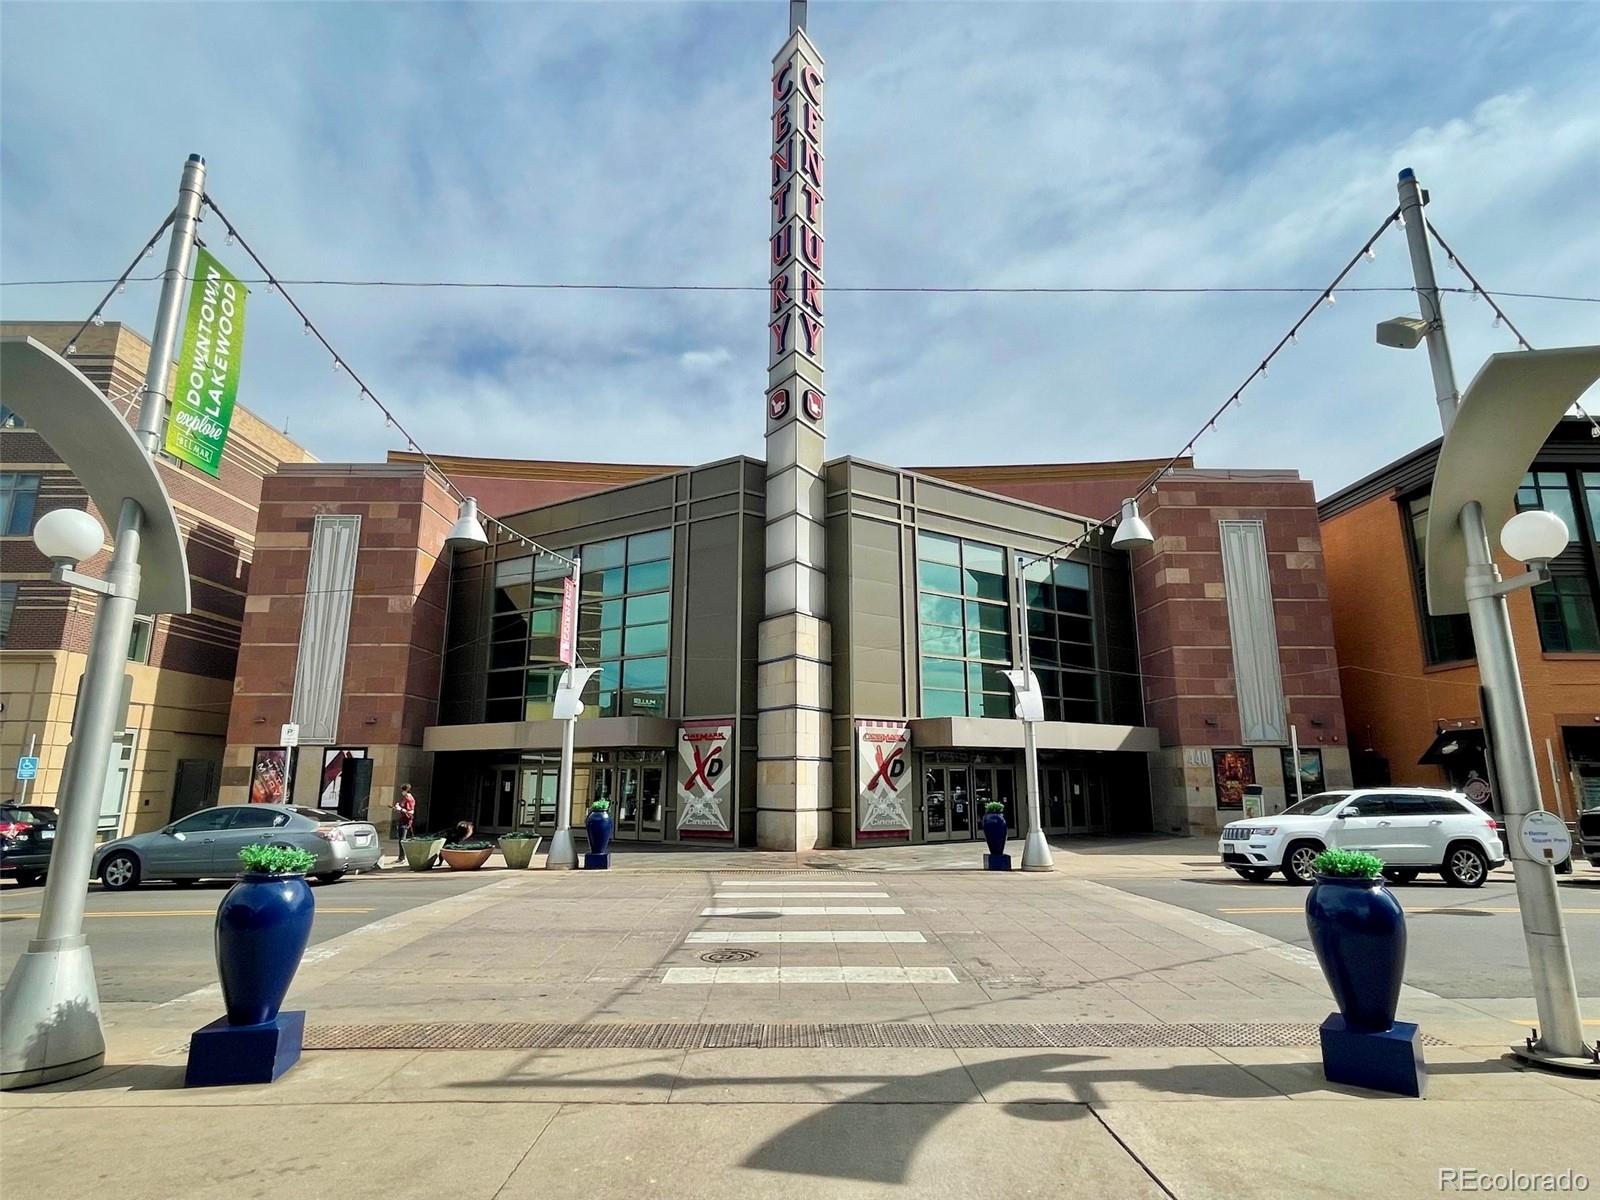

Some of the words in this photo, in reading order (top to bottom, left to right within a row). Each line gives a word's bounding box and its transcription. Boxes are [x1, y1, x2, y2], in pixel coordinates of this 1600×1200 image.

[771, 60, 793, 355] CENTURY
[801, 64, 824, 357] CENTURY
[186, 265, 222, 408] DOWNTOWN
[204, 282, 238, 418] LAKEWOOD
[175, 410, 223, 441] explore
[178, 437, 211, 461] BELMAR
[682, 732, 727, 742] CINEMARK
[1188, 751, 1208, 766] 440
[683, 744, 724, 792] XD
[867, 744, 905, 792] XD
